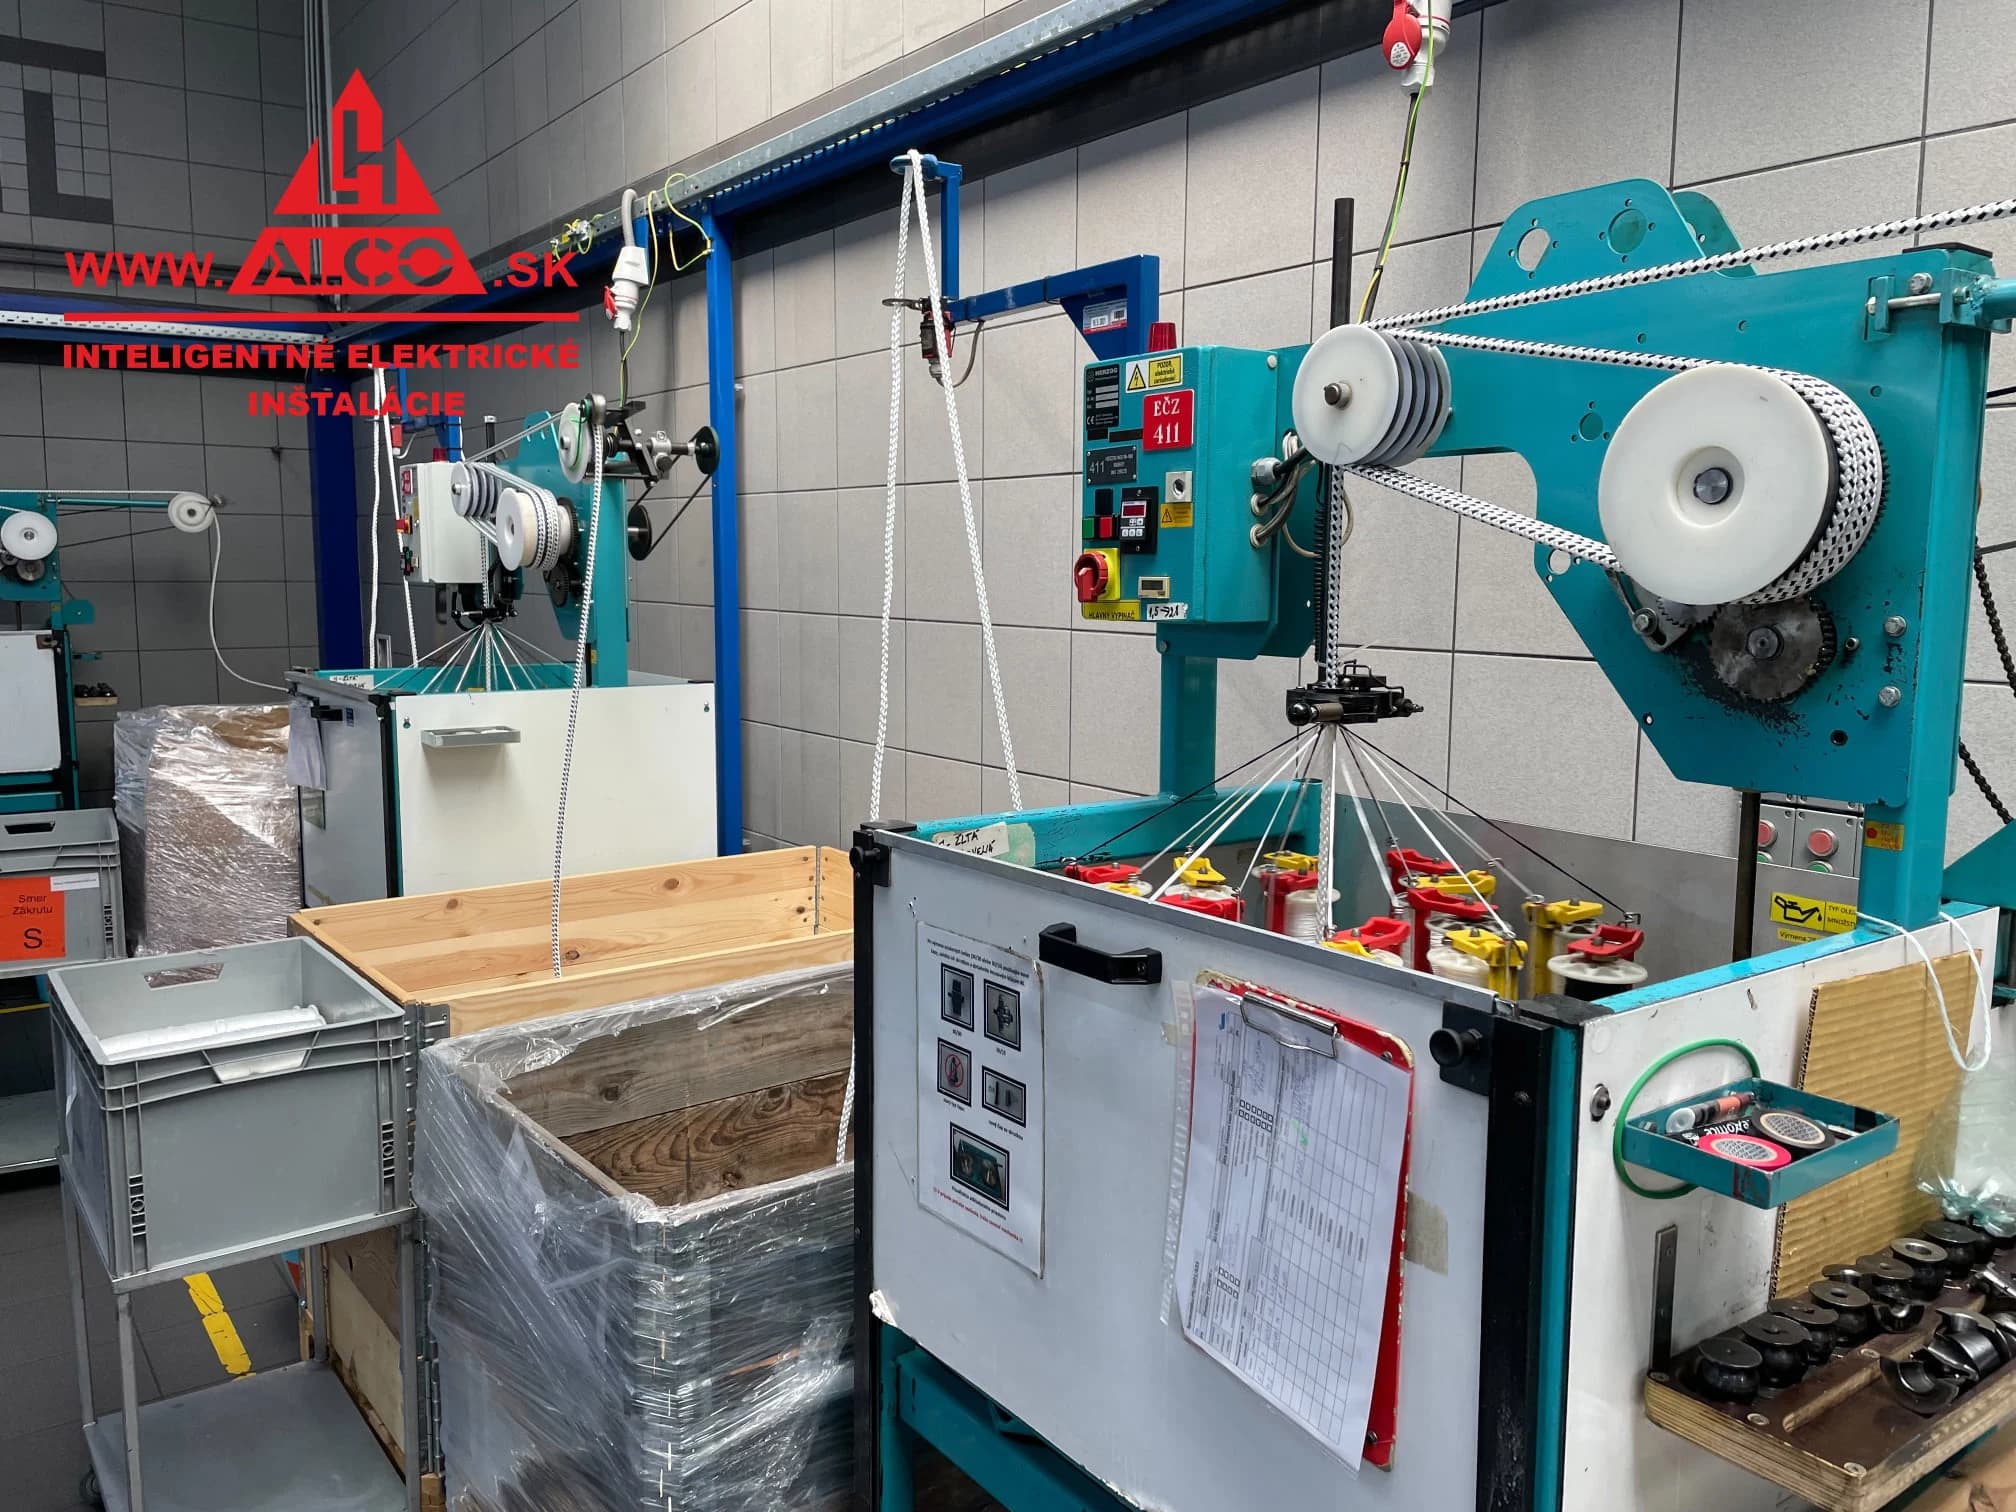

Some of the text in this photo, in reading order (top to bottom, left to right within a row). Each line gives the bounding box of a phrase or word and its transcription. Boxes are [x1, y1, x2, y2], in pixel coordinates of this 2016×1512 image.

[1153, 396, 1180, 417] EČZ
[1153, 422, 1180, 444] 411
[1089, 460, 1105, 474] 411
[18, 894, 47, 903] Smer
[23, 927, 43, 950] S
